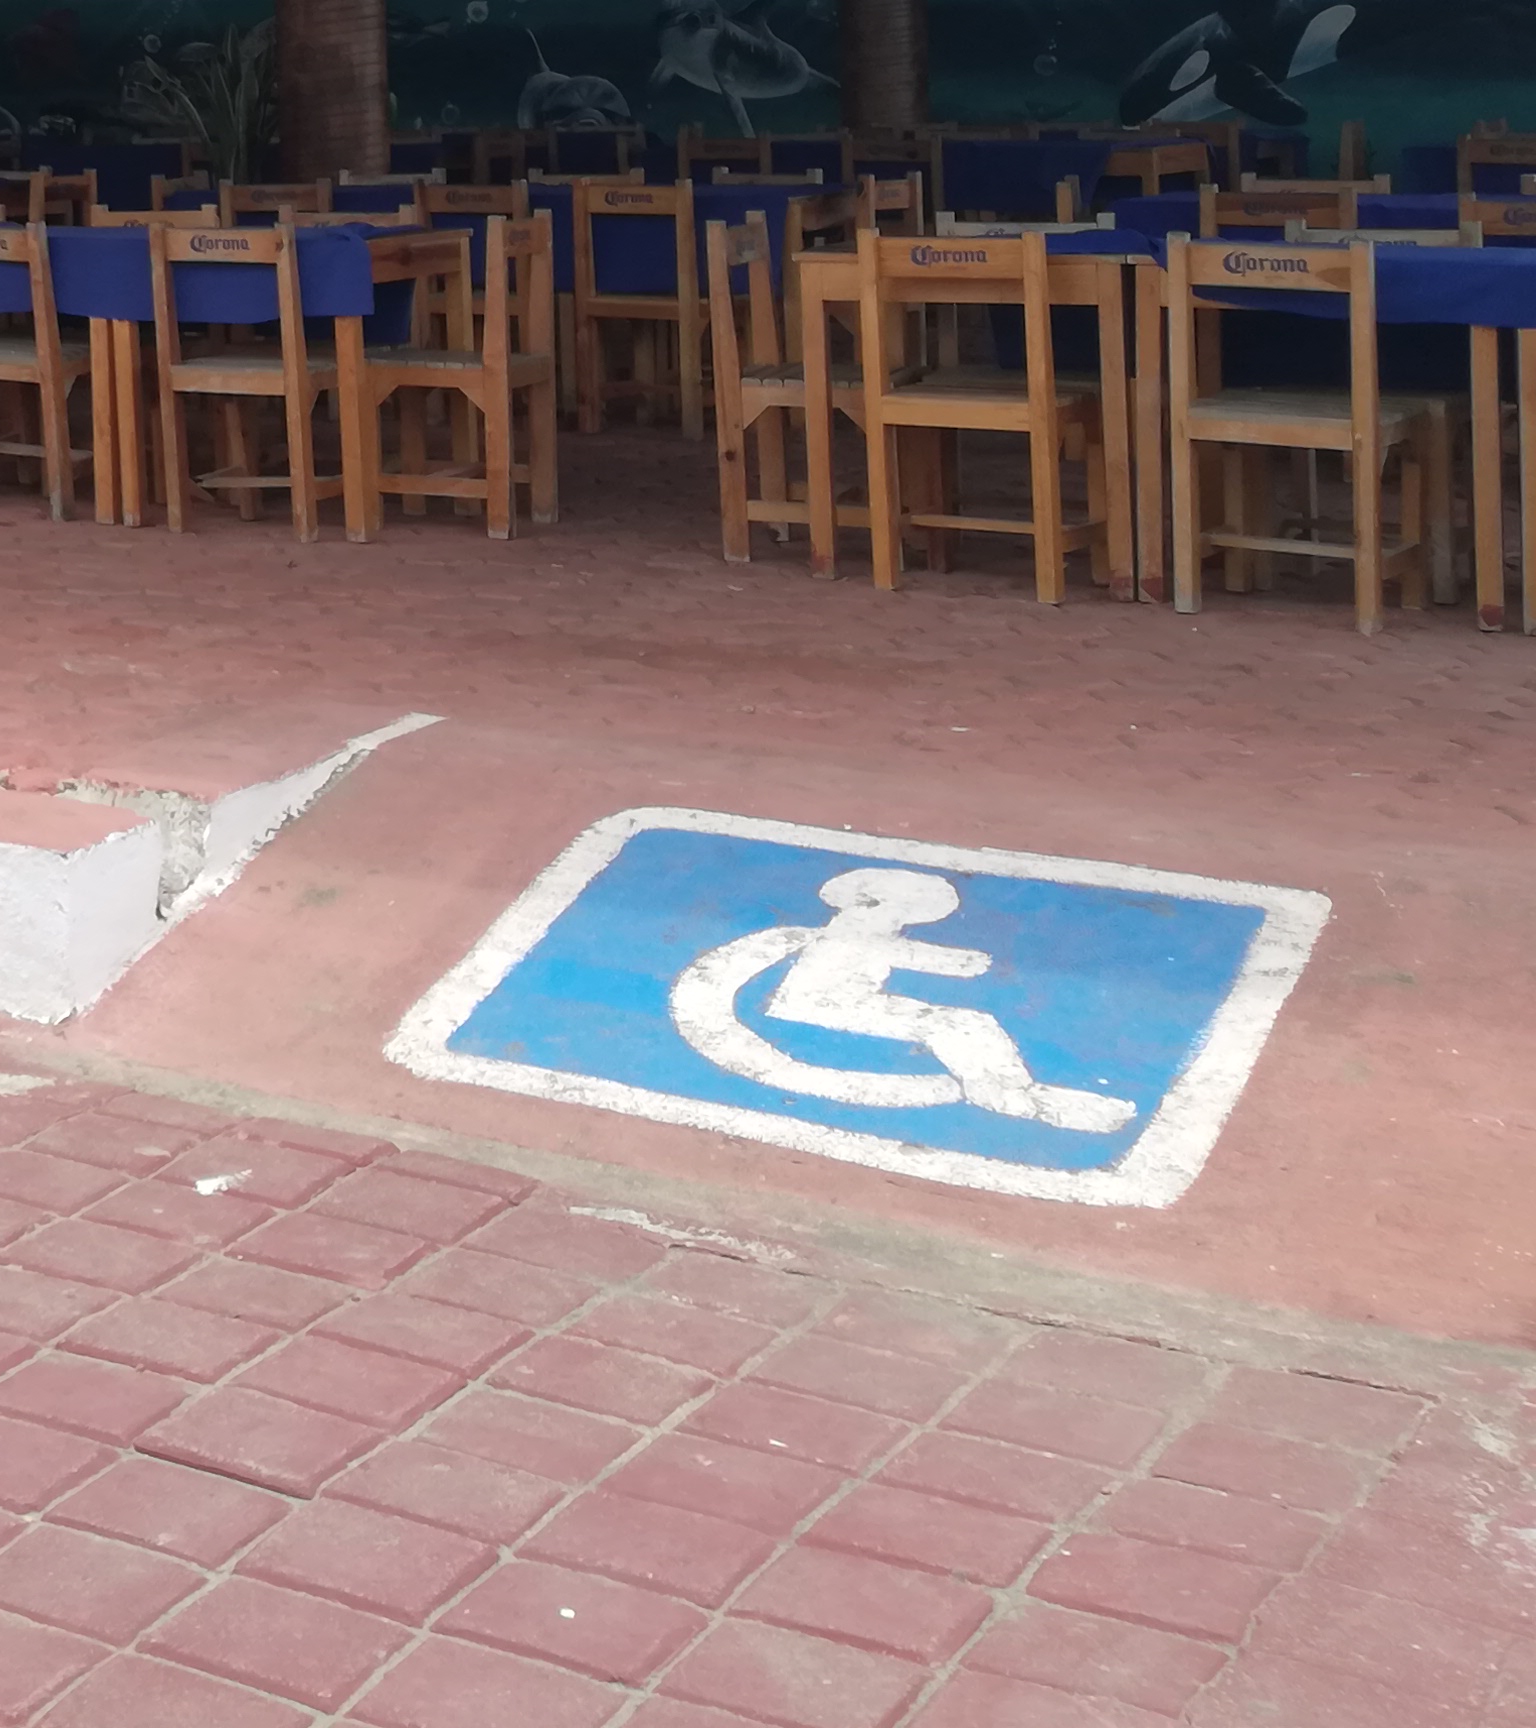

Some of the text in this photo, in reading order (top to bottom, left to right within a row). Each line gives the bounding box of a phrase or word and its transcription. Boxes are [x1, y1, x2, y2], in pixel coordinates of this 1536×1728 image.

[604, 190, 654, 207] Corona
[189, 234, 250, 254] Corona
[910, 244, 988, 268] Corona
[1222, 249, 1310, 276] Corona
